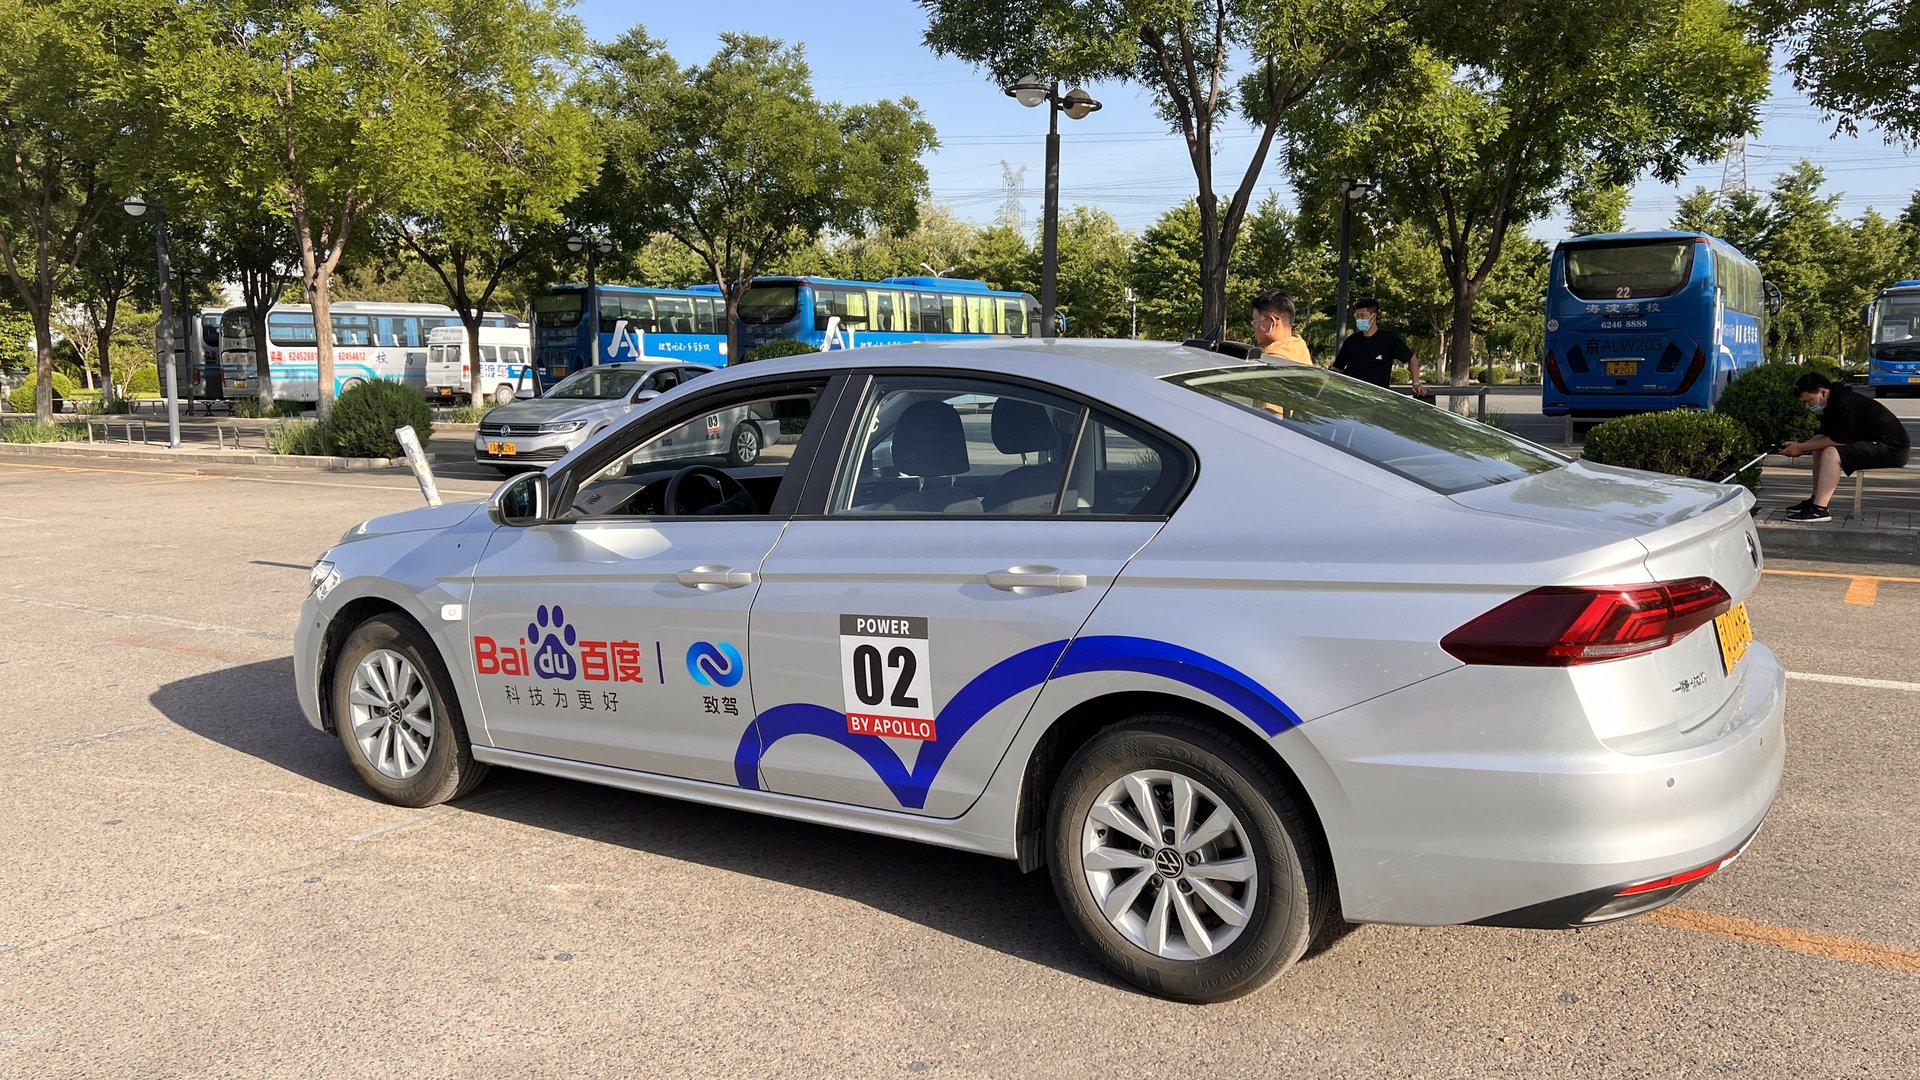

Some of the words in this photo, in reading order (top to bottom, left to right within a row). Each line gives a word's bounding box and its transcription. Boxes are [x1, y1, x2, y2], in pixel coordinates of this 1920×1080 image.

[1616, 287, 1631, 298] 22
[1586, 302, 1661, 314] 海淀驾校
[1601, 321, 1622, 329] 6246
[1625, 320, 1648, 328] 8888
[707, 415, 718, 427] 03
[857, 618, 910, 635] POWER
[578, 640, 643, 684] 百度
[853, 644, 919, 708] 02
[505, 685, 619, 712] 科技为更好
[703, 695, 739, 716] 致驾
[851, 716, 869, 732] BY
[874, 718, 931, 738] APOLLO
[1155, 743, 1238, 790] SOLUS
